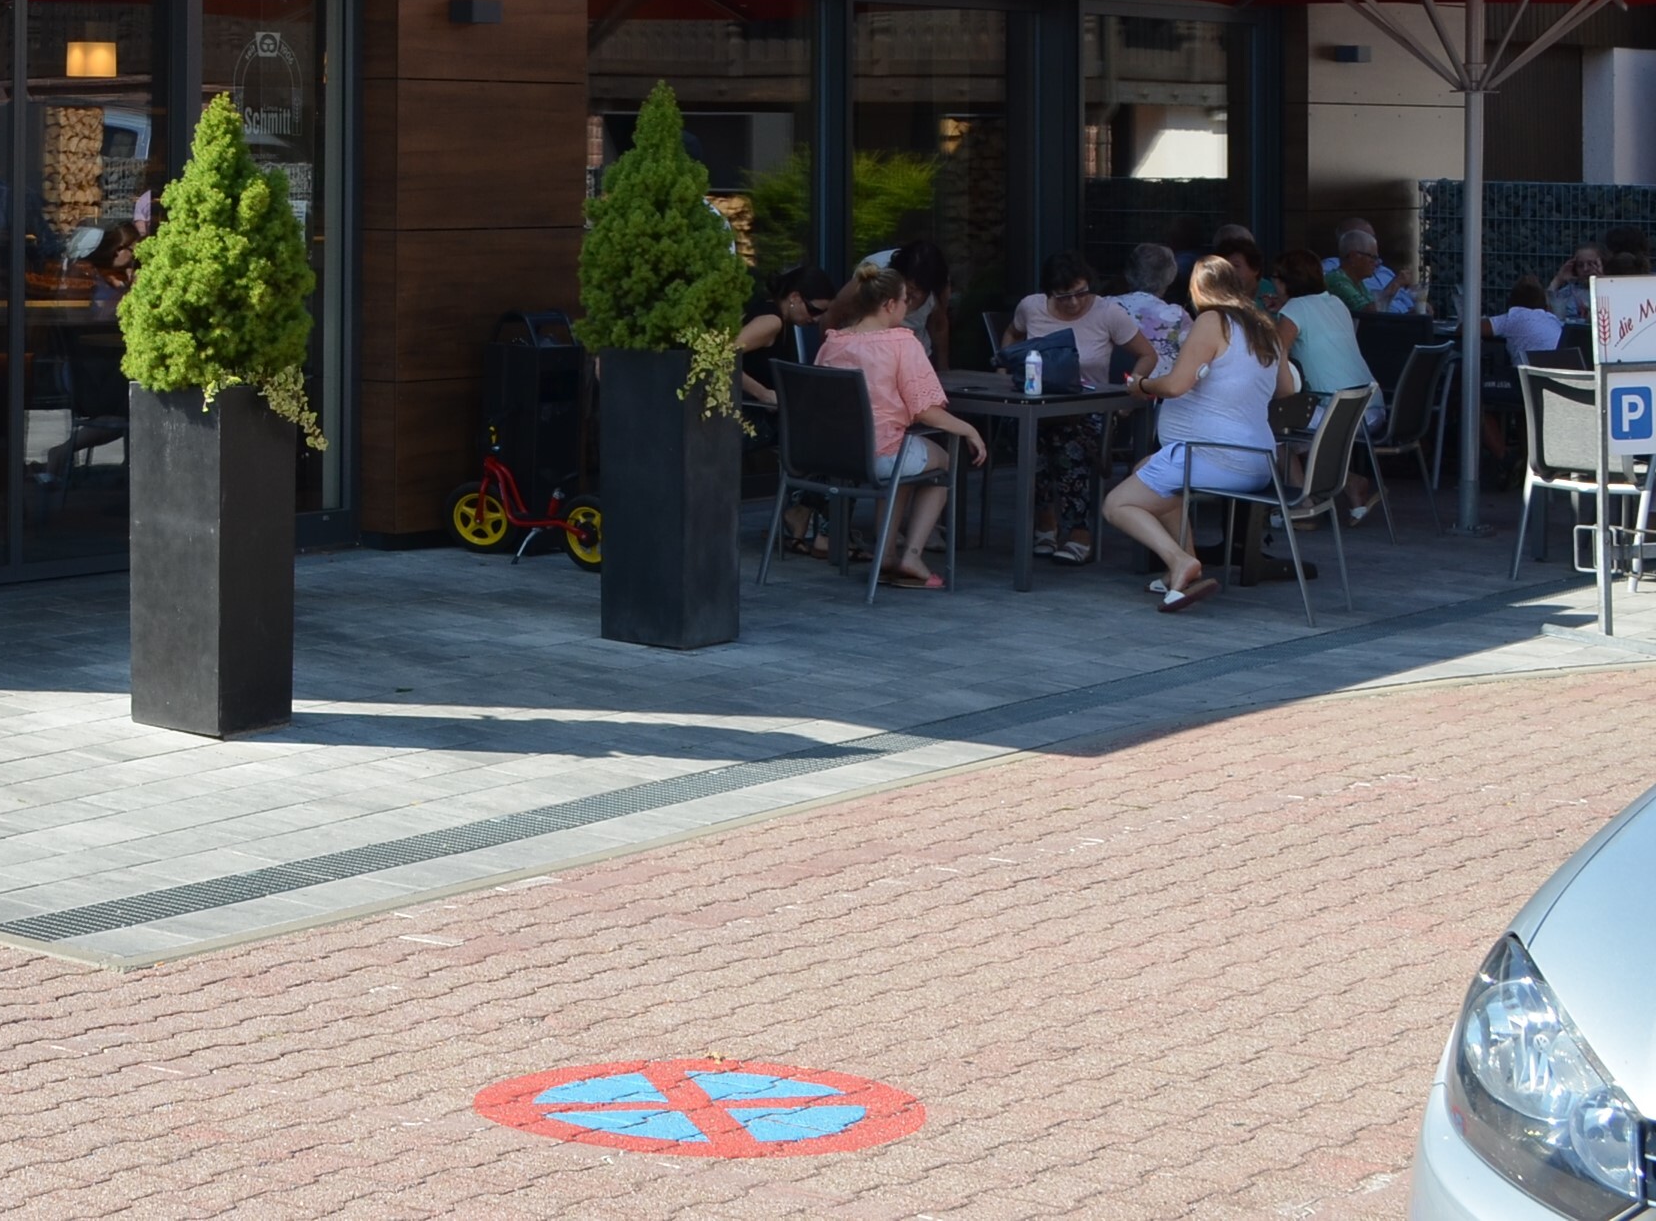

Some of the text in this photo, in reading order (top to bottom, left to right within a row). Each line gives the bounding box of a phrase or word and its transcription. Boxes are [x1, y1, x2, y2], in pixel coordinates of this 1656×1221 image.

[244, 106, 291, 135] Schmitt
[1639, 298, 1656, 323] M
[1621, 394, 1645, 432] P
